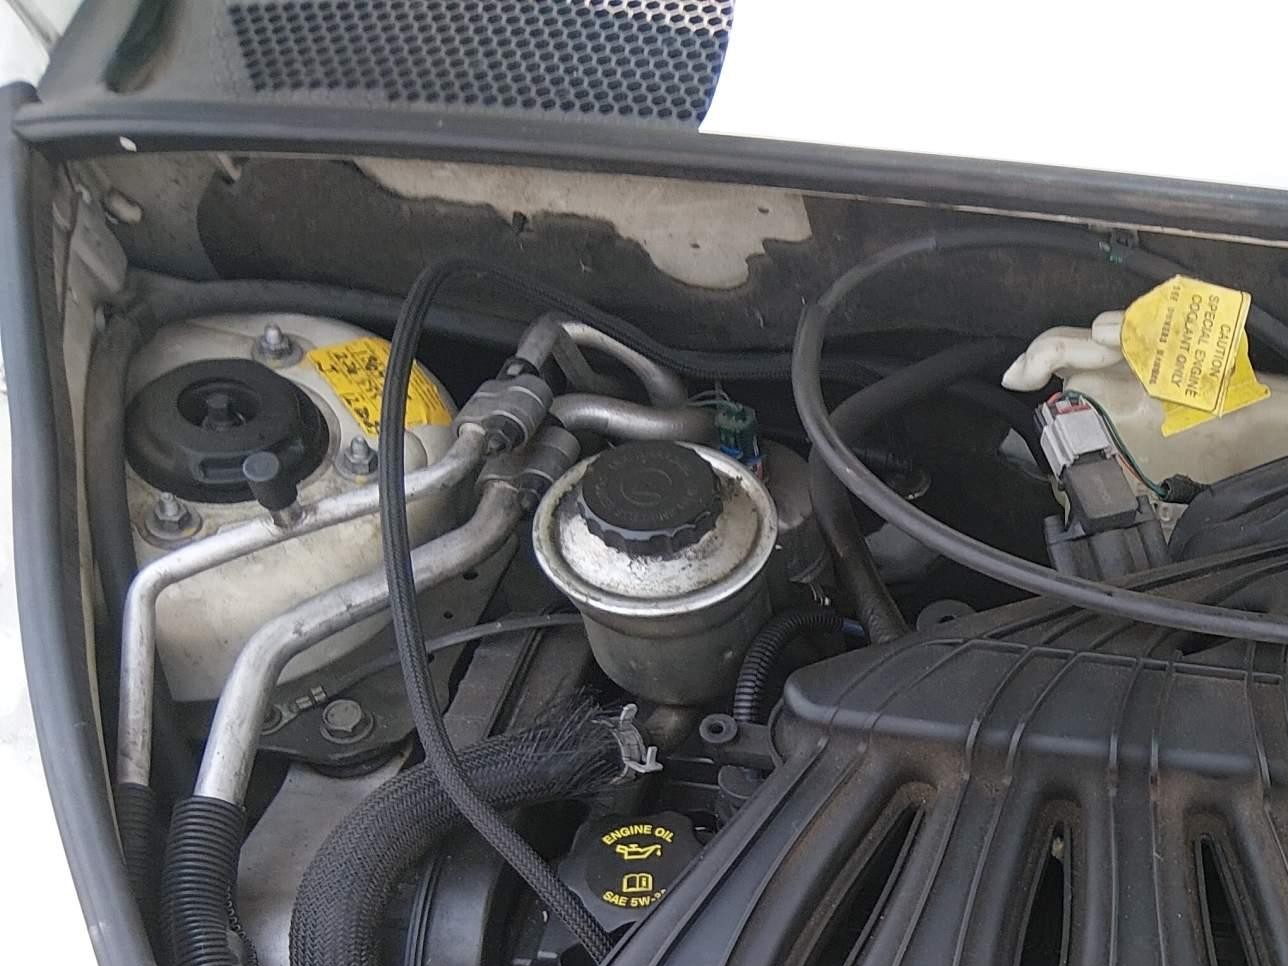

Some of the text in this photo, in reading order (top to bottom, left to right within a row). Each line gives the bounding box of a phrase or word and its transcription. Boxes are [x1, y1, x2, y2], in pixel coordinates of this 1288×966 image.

[1171, 294, 1202, 388] COOLANT ONLY
[1185, 294, 1220, 398] SPECIAL ENGINE
[1209, 323, 1231, 378] CAUTION
[602, 825, 675, 845] ENGINE OIL
[602, 891, 627, 907] SAE
